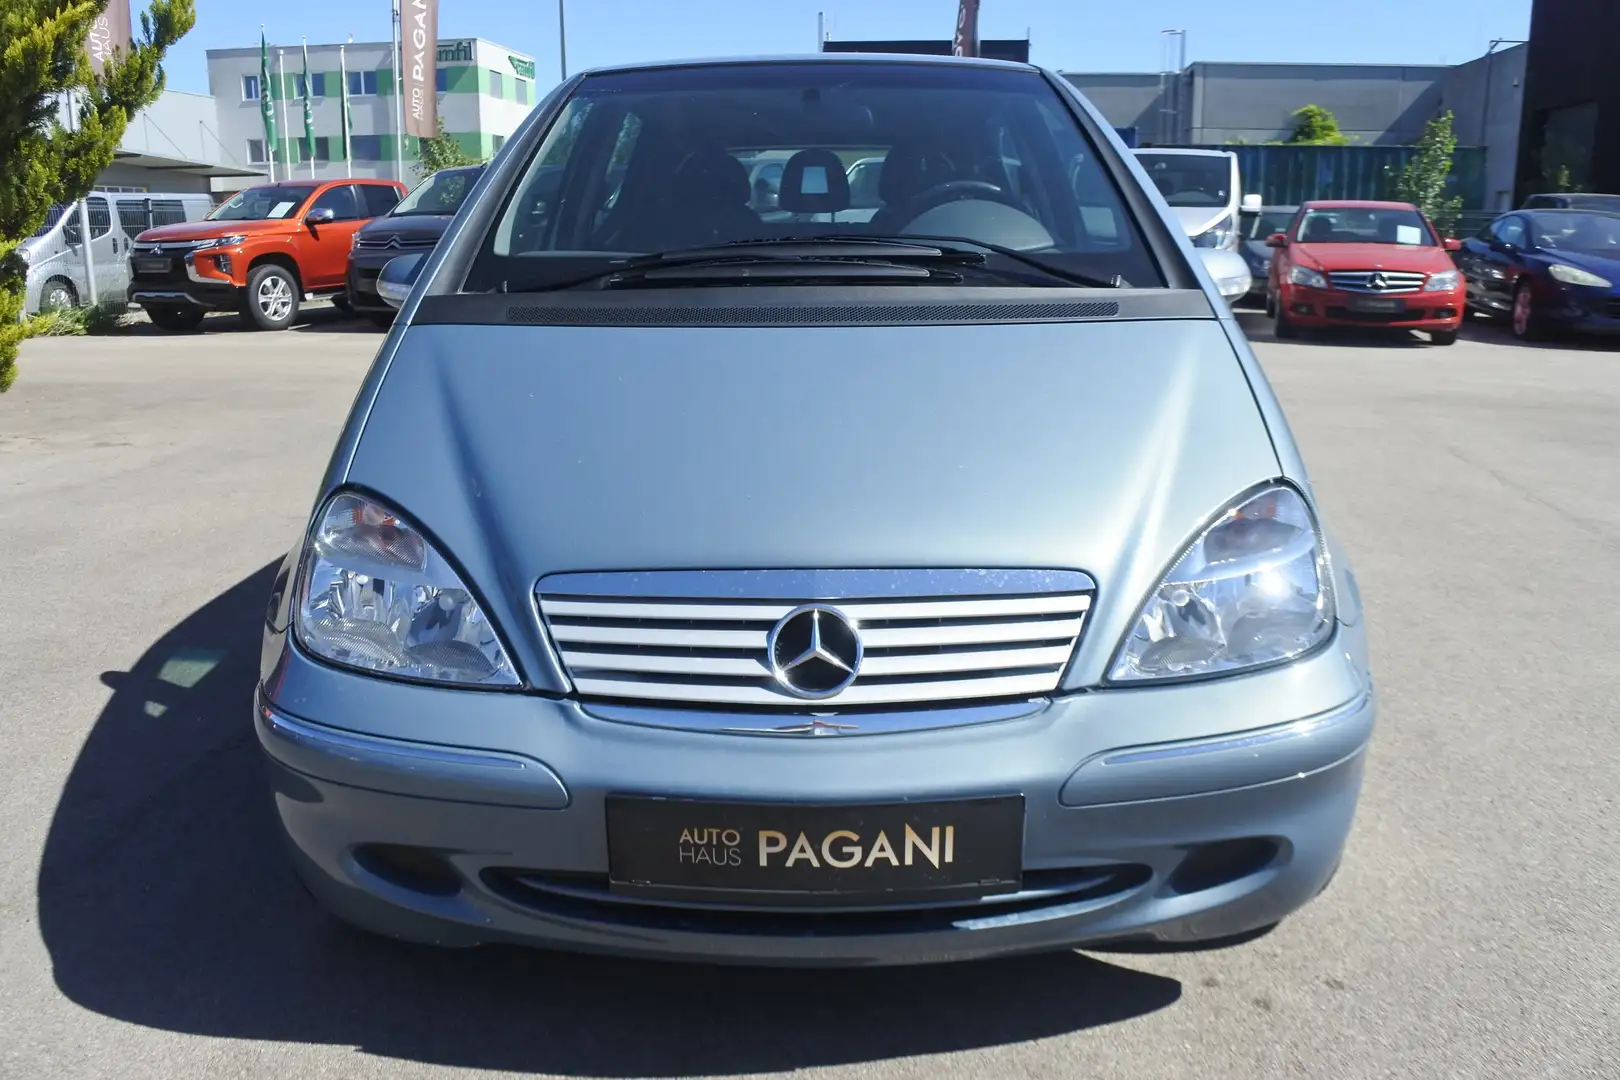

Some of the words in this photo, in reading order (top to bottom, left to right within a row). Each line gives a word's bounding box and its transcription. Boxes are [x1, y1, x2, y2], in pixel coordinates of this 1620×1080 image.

[412, 87, 420, 120] AUTO
[679, 828, 741, 846] AUTO
[758, 822, 954, 869] PAGANI
[679, 846, 742, 866] HAUS
